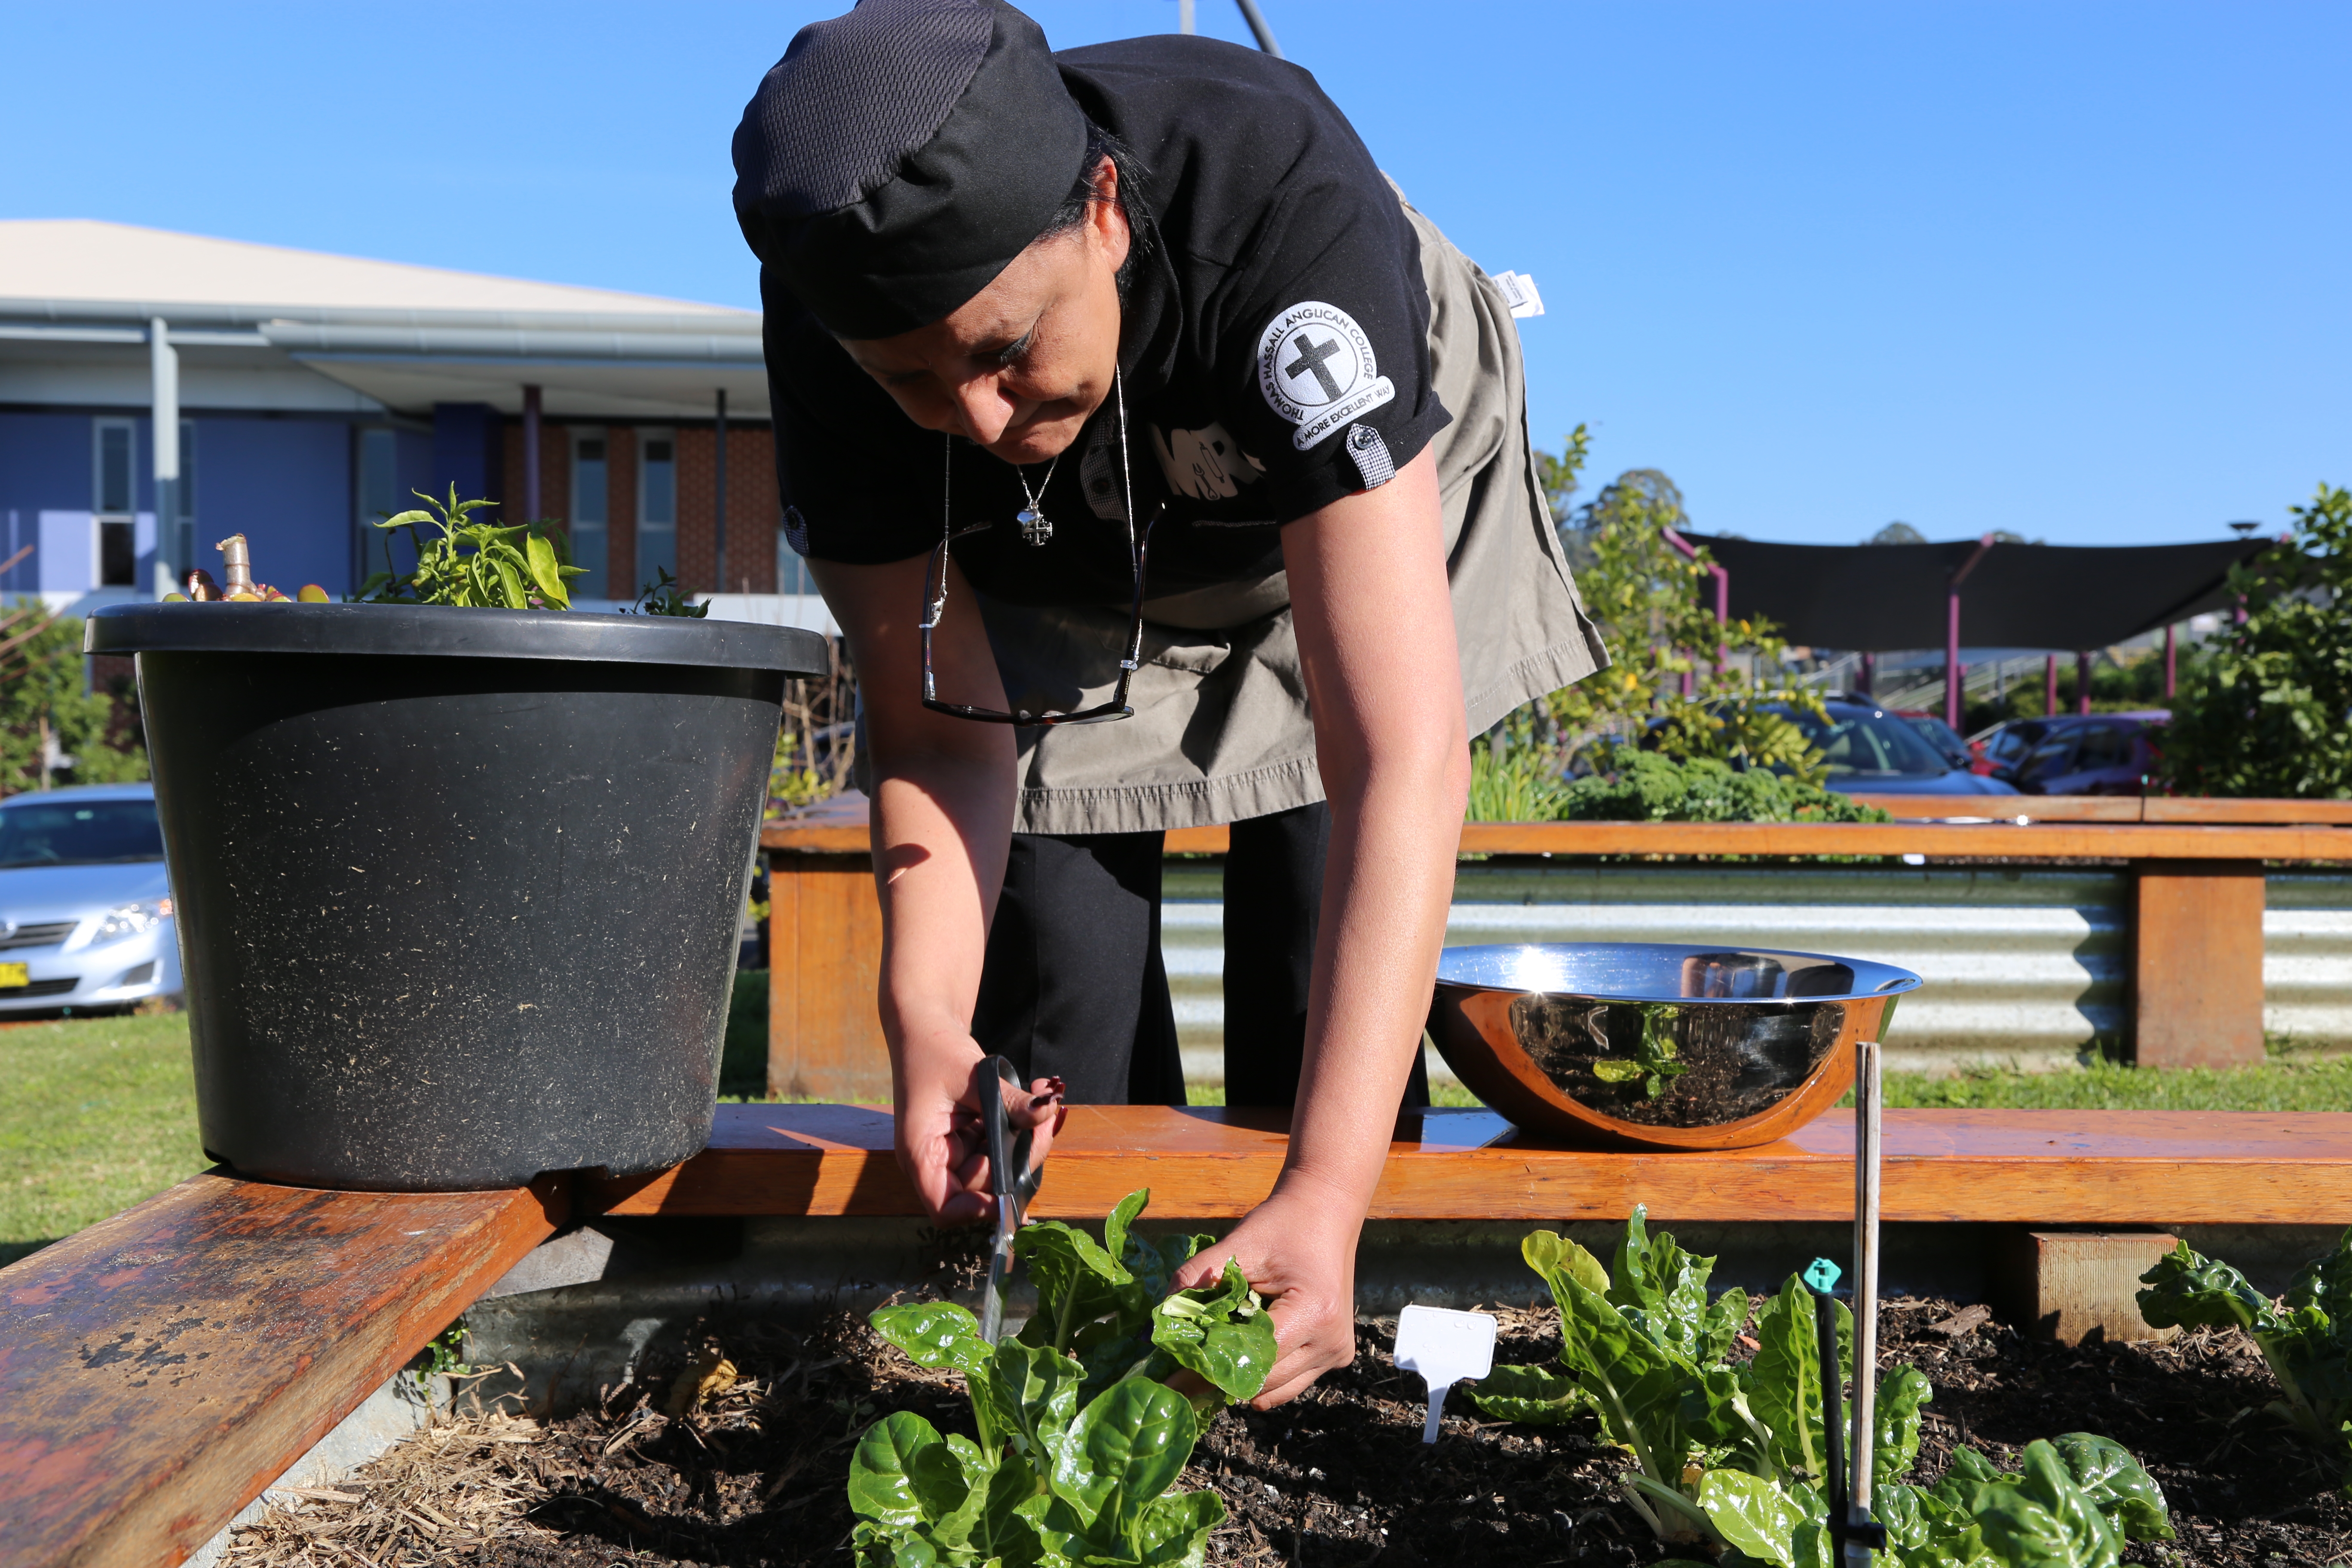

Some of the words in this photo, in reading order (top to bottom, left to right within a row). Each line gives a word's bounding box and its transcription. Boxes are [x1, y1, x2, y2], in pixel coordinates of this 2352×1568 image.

[1285, 308, 1349, 330] ANGLICAN
[1264, 327, 1285, 380] HASSALL
[1350, 328, 1373, 380] COLLEGE
[1265, 381, 1304, 421] THOMAS
[1297, 437, 1305, 447] A
[1304, 419, 1329, 441] MORE
[1330, 393, 1374, 423] EXCELLENT
[1375, 385, 1390, 399] WAY
